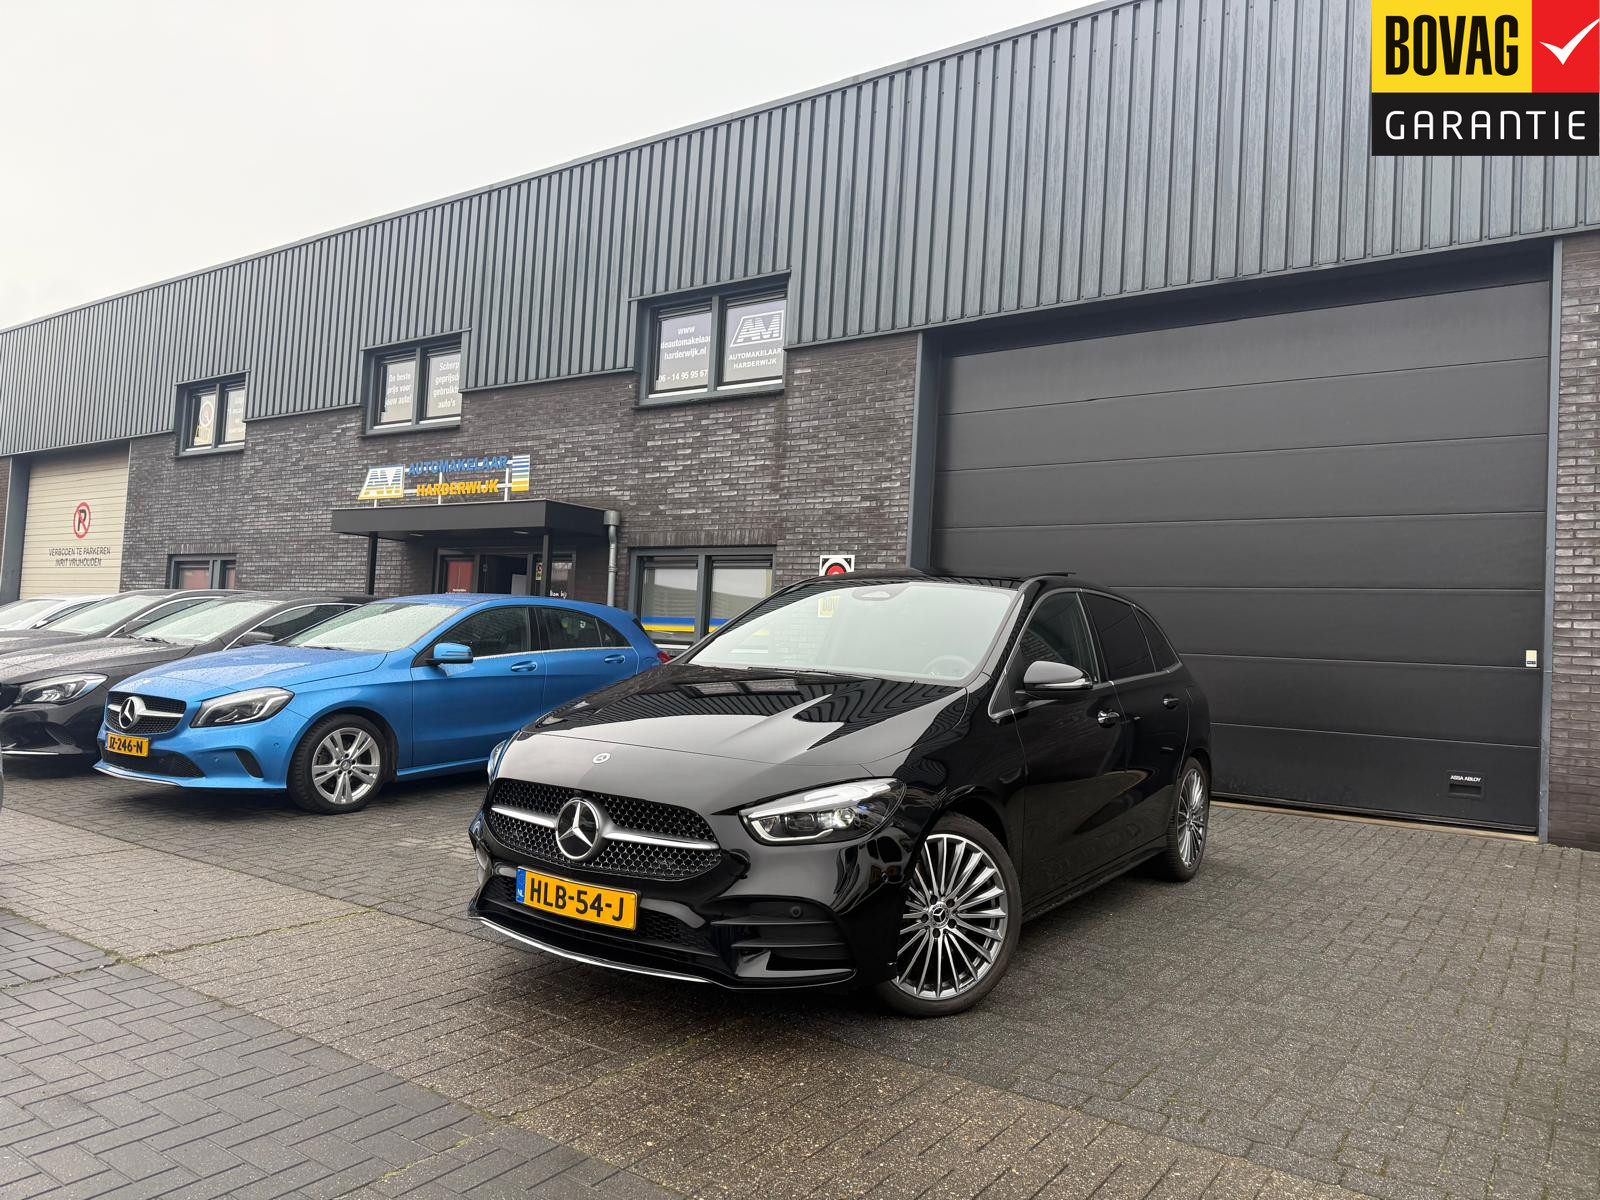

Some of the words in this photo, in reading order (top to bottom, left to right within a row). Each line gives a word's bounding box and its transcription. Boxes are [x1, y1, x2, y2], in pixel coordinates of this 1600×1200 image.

[677, 326, 695, 335] www
[729, 347, 782, 361] AUTOMAKELAAR
[733, 358, 777, 369] HARDERWIJK
[408, 456, 507, 476] AUTOMAKELAAR
[416, 479, 499, 496] HARDERWIJK
[49, 547, 76, 556] VERBODEN
[76, 547, 82, 555] TE
[83, 546, 111, 556] PARKEREN
[530, 877, 624, 921] HLB-54-J
